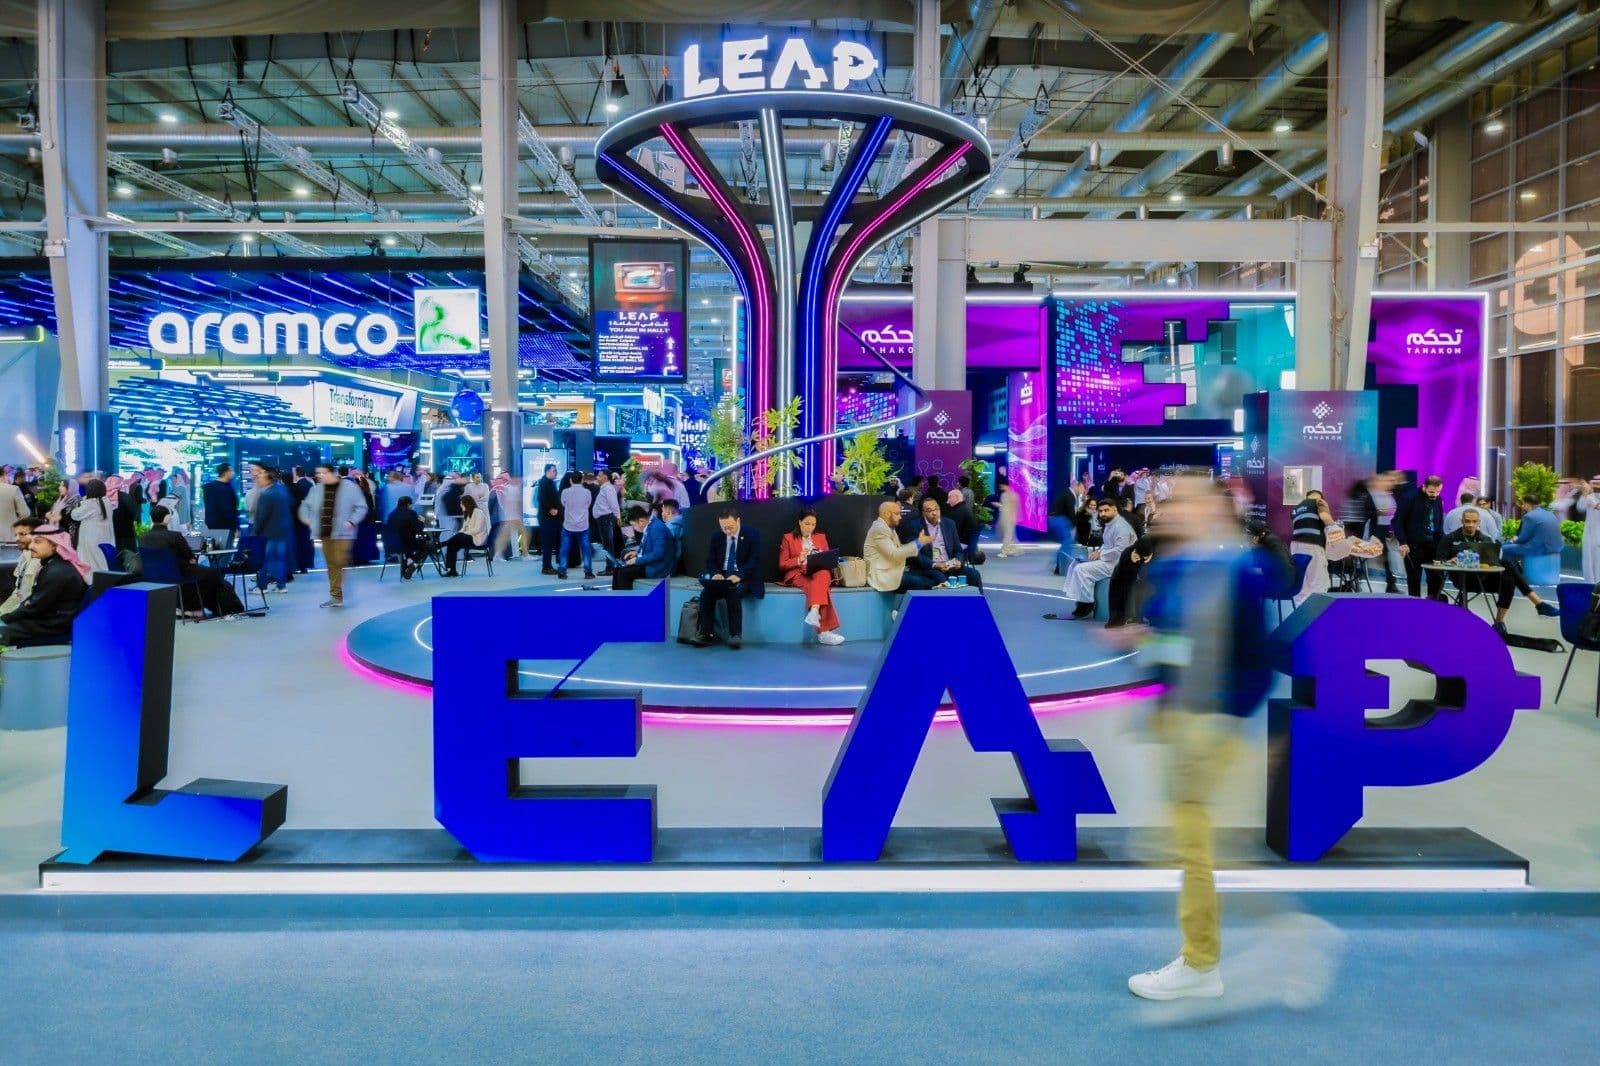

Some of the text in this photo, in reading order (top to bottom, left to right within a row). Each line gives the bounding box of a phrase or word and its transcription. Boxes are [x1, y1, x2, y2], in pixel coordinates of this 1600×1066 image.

[683, 35, 878, 98] LEAP
[619, 311, 660, 320] LEAP
[148, 311, 398, 355] aramco
[861, 325, 914, 344] حكم
[1406, 328, 1464, 346] تحكم
[329, 388, 373, 412] Transforming
[329, 407, 388, 428] Energy Landscape
[680, 433, 708, 443] CISCO
[926, 428, 961, 439] تحكم
[1303, 422, 1344, 435] تحكم
[57, 579, 1540, 863] LEAP
